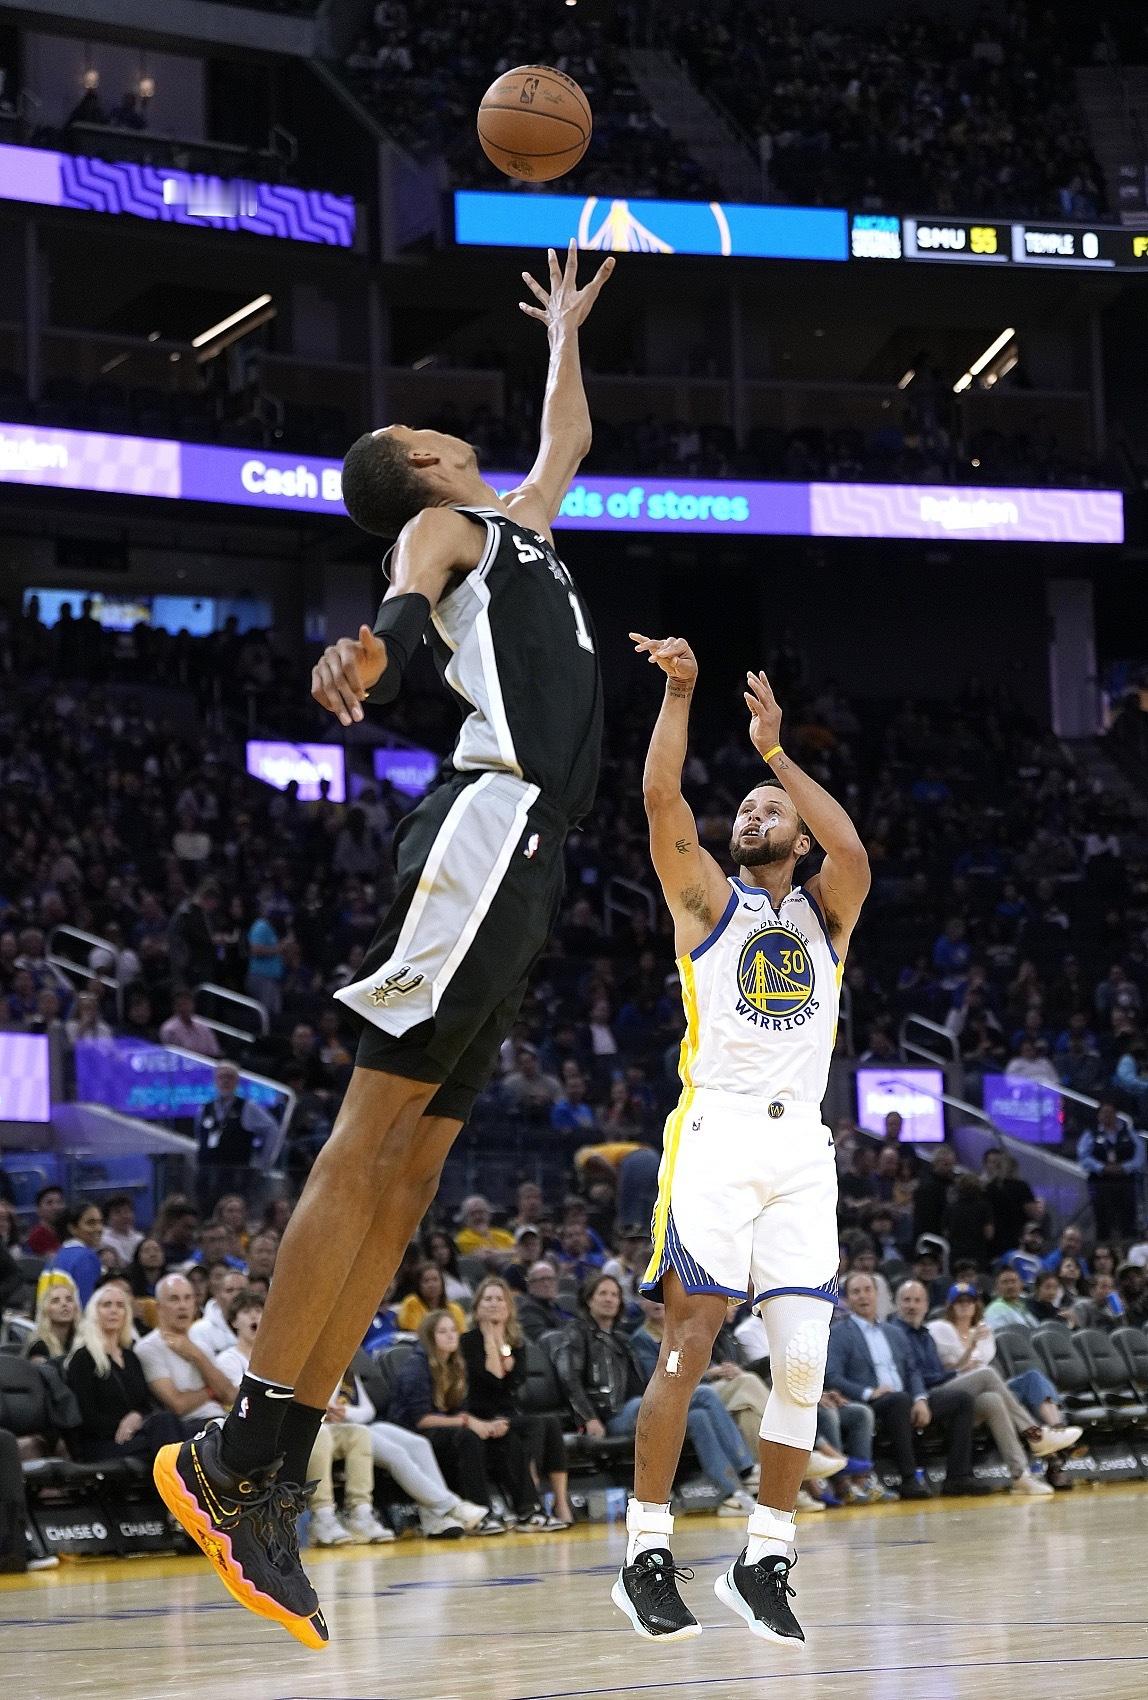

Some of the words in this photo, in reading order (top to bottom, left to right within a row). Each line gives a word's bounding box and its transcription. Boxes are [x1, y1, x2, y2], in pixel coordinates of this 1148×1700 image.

[916, 226, 966, 250] SMU
[1024, 232, 1075, 255] TEMPLE
[1133, 236, 1148, 257] F
[241, 459, 319, 498] Cash
[606, 486, 645, 519] of
[647, 490, 749, 521] stores
[785, 919, 811, 947] STATE
[779, 949, 806, 976] 30
[734, 997, 821, 1032] WARRIORS
[45, 1524, 93, 1541] CHASE
[119, 1521, 164, 1537] CHASE
